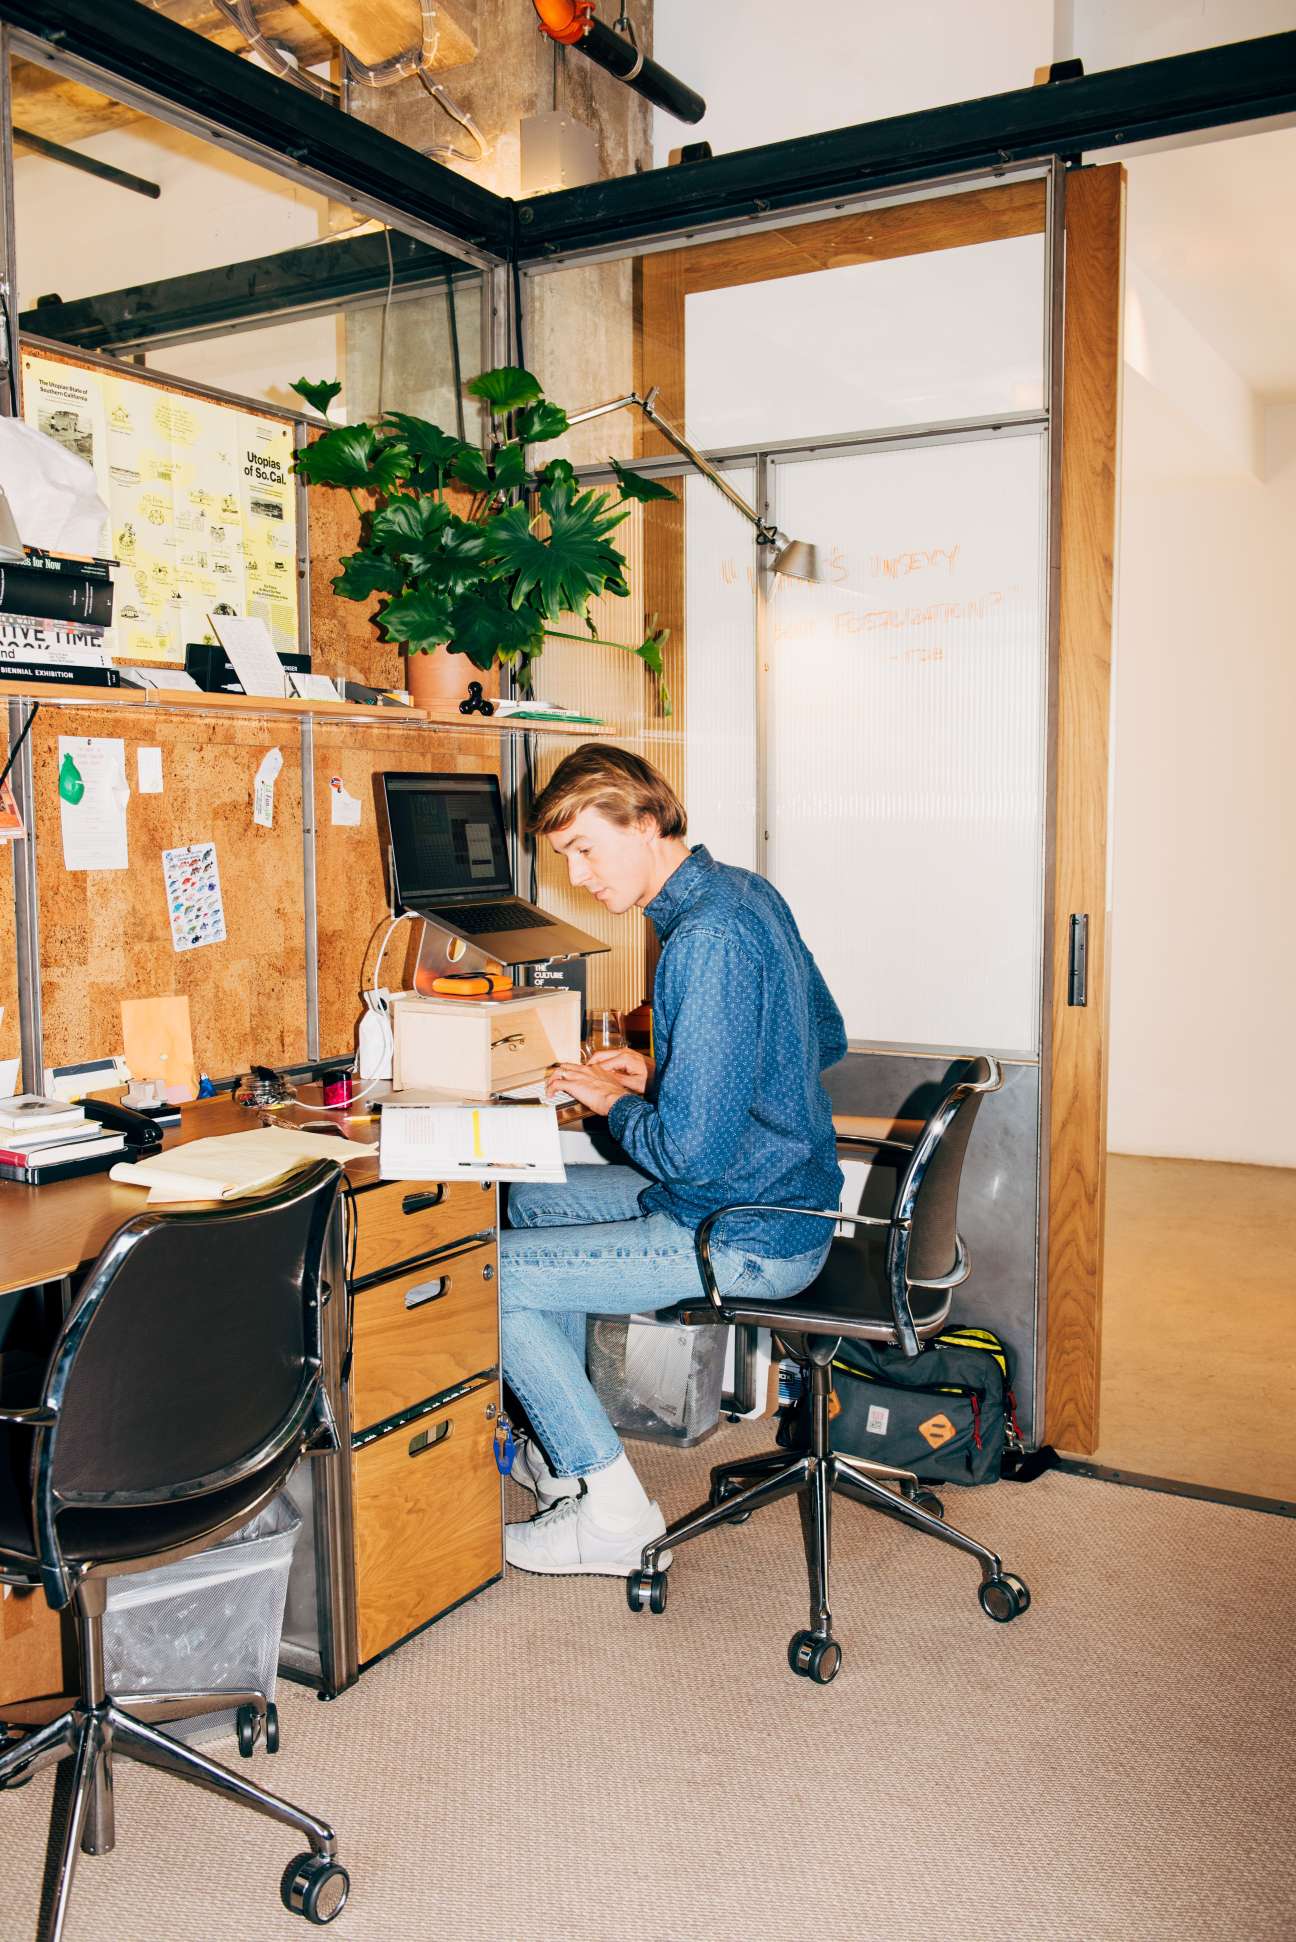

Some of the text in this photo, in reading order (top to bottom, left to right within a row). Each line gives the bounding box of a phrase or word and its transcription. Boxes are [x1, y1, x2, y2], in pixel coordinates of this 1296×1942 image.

[40, 386, 88, 402] Southern California
[49, 381, 68, 390] Utopian
[69, 386, 82, 394] State
[247, 451, 281, 470] Utopias
[244, 465, 254, 477] of
[32, 556, 43, 568] for
[45, 558, 61, 570] Now
[0, 666, 74, 678] BIENNIAL EXHIBITION
